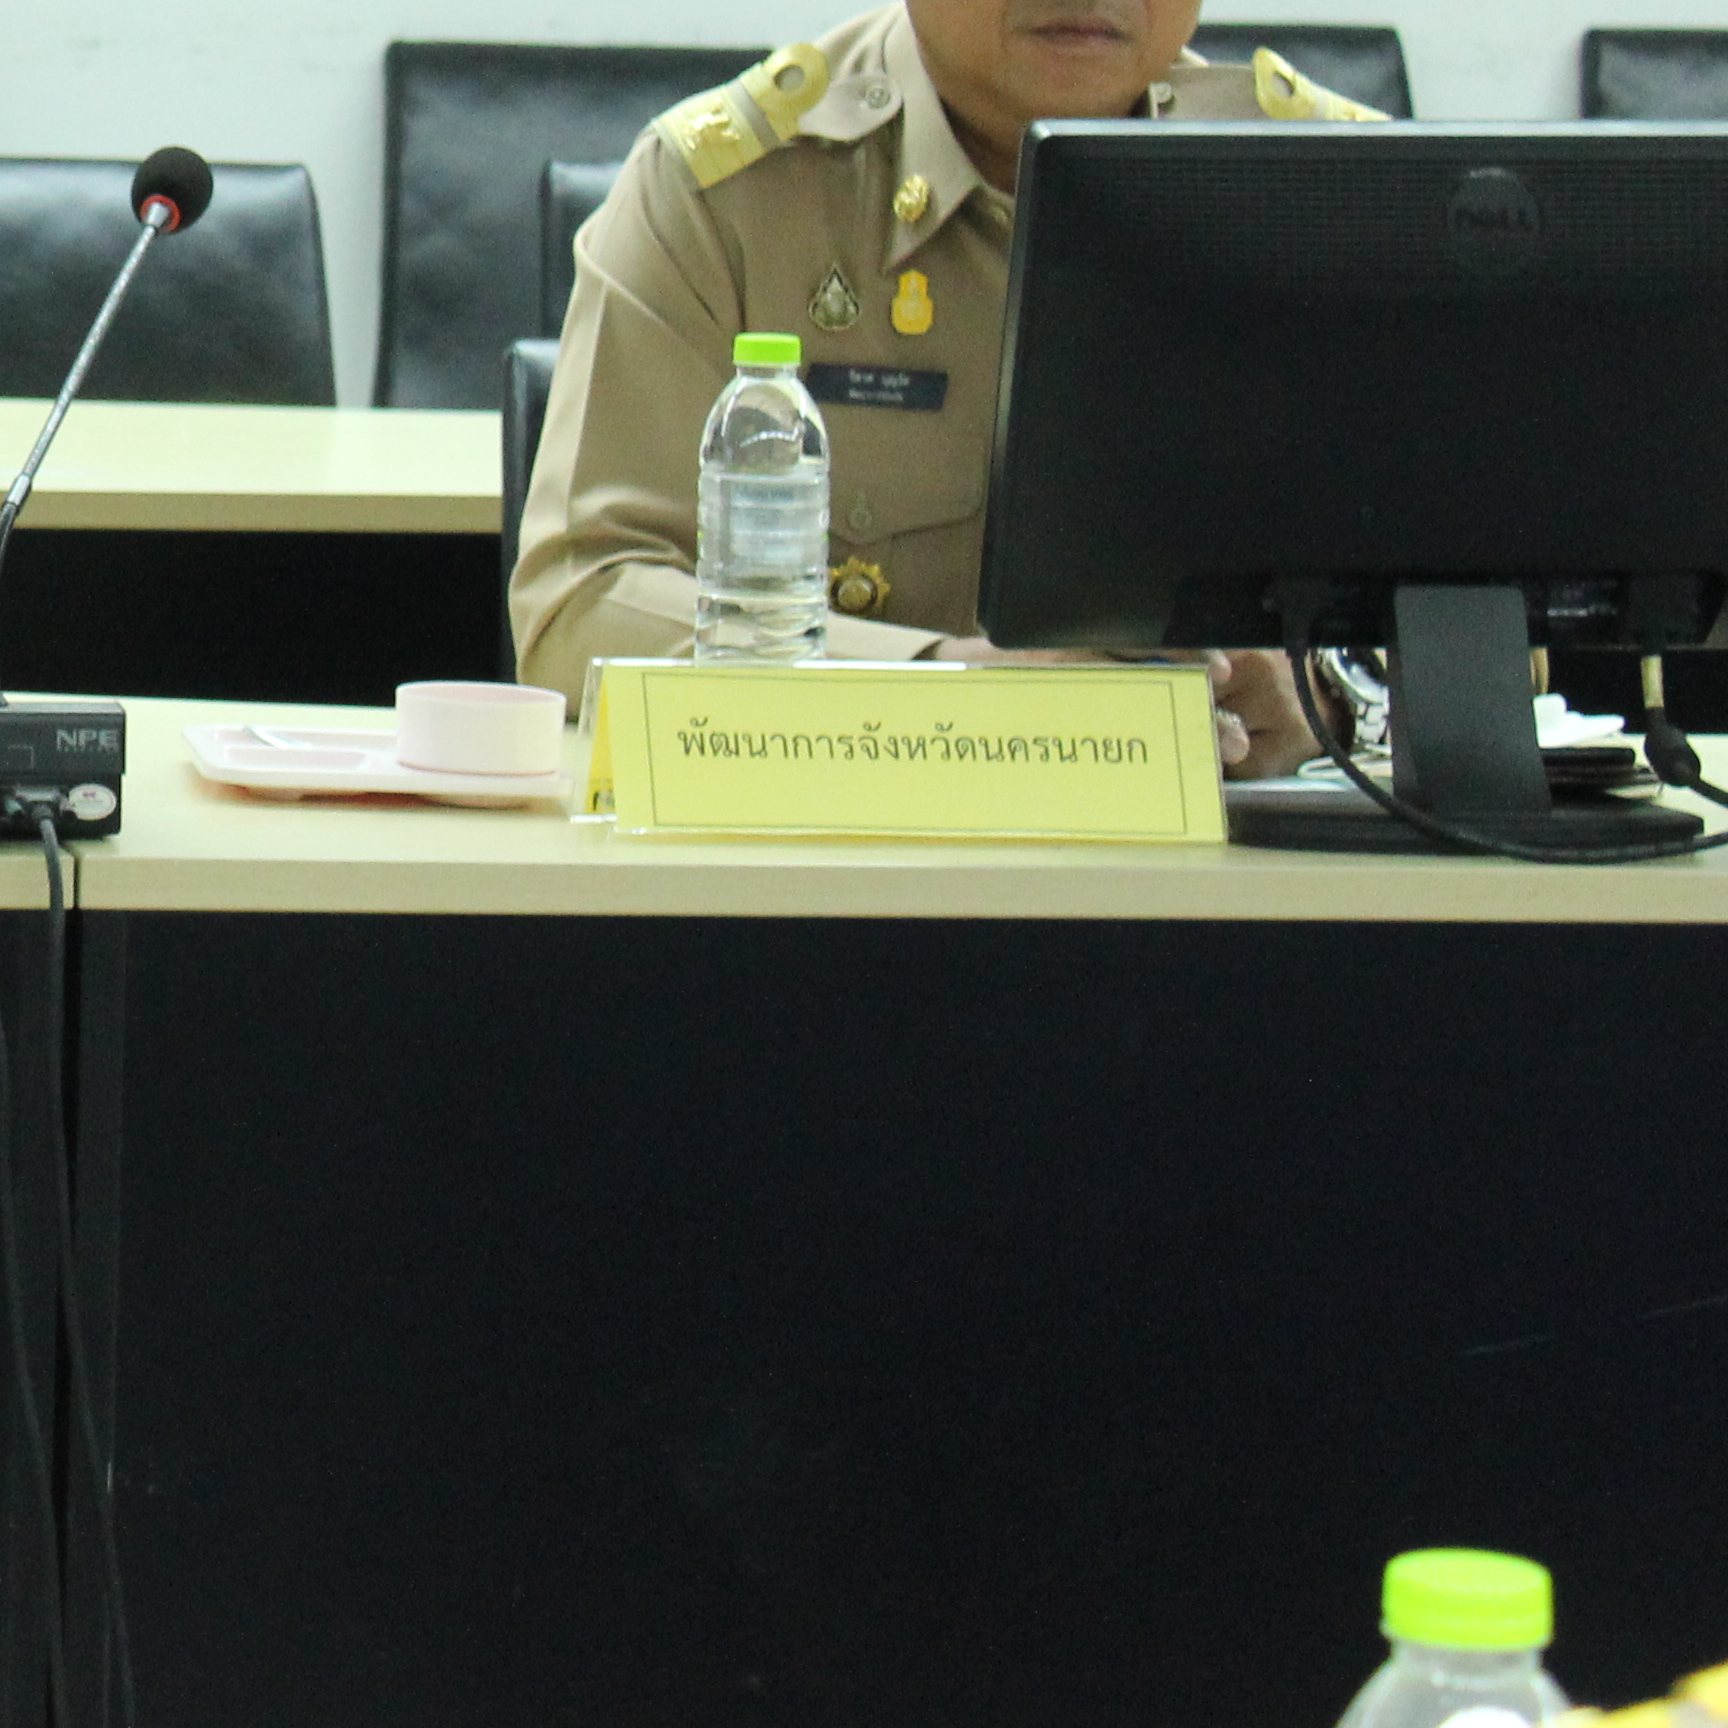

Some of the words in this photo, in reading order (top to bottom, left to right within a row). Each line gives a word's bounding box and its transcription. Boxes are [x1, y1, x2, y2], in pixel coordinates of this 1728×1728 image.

[56, 729, 119, 747] NPE
[677, 716, 1149, 765] พัฒนาการจังหวัดนครนายก
